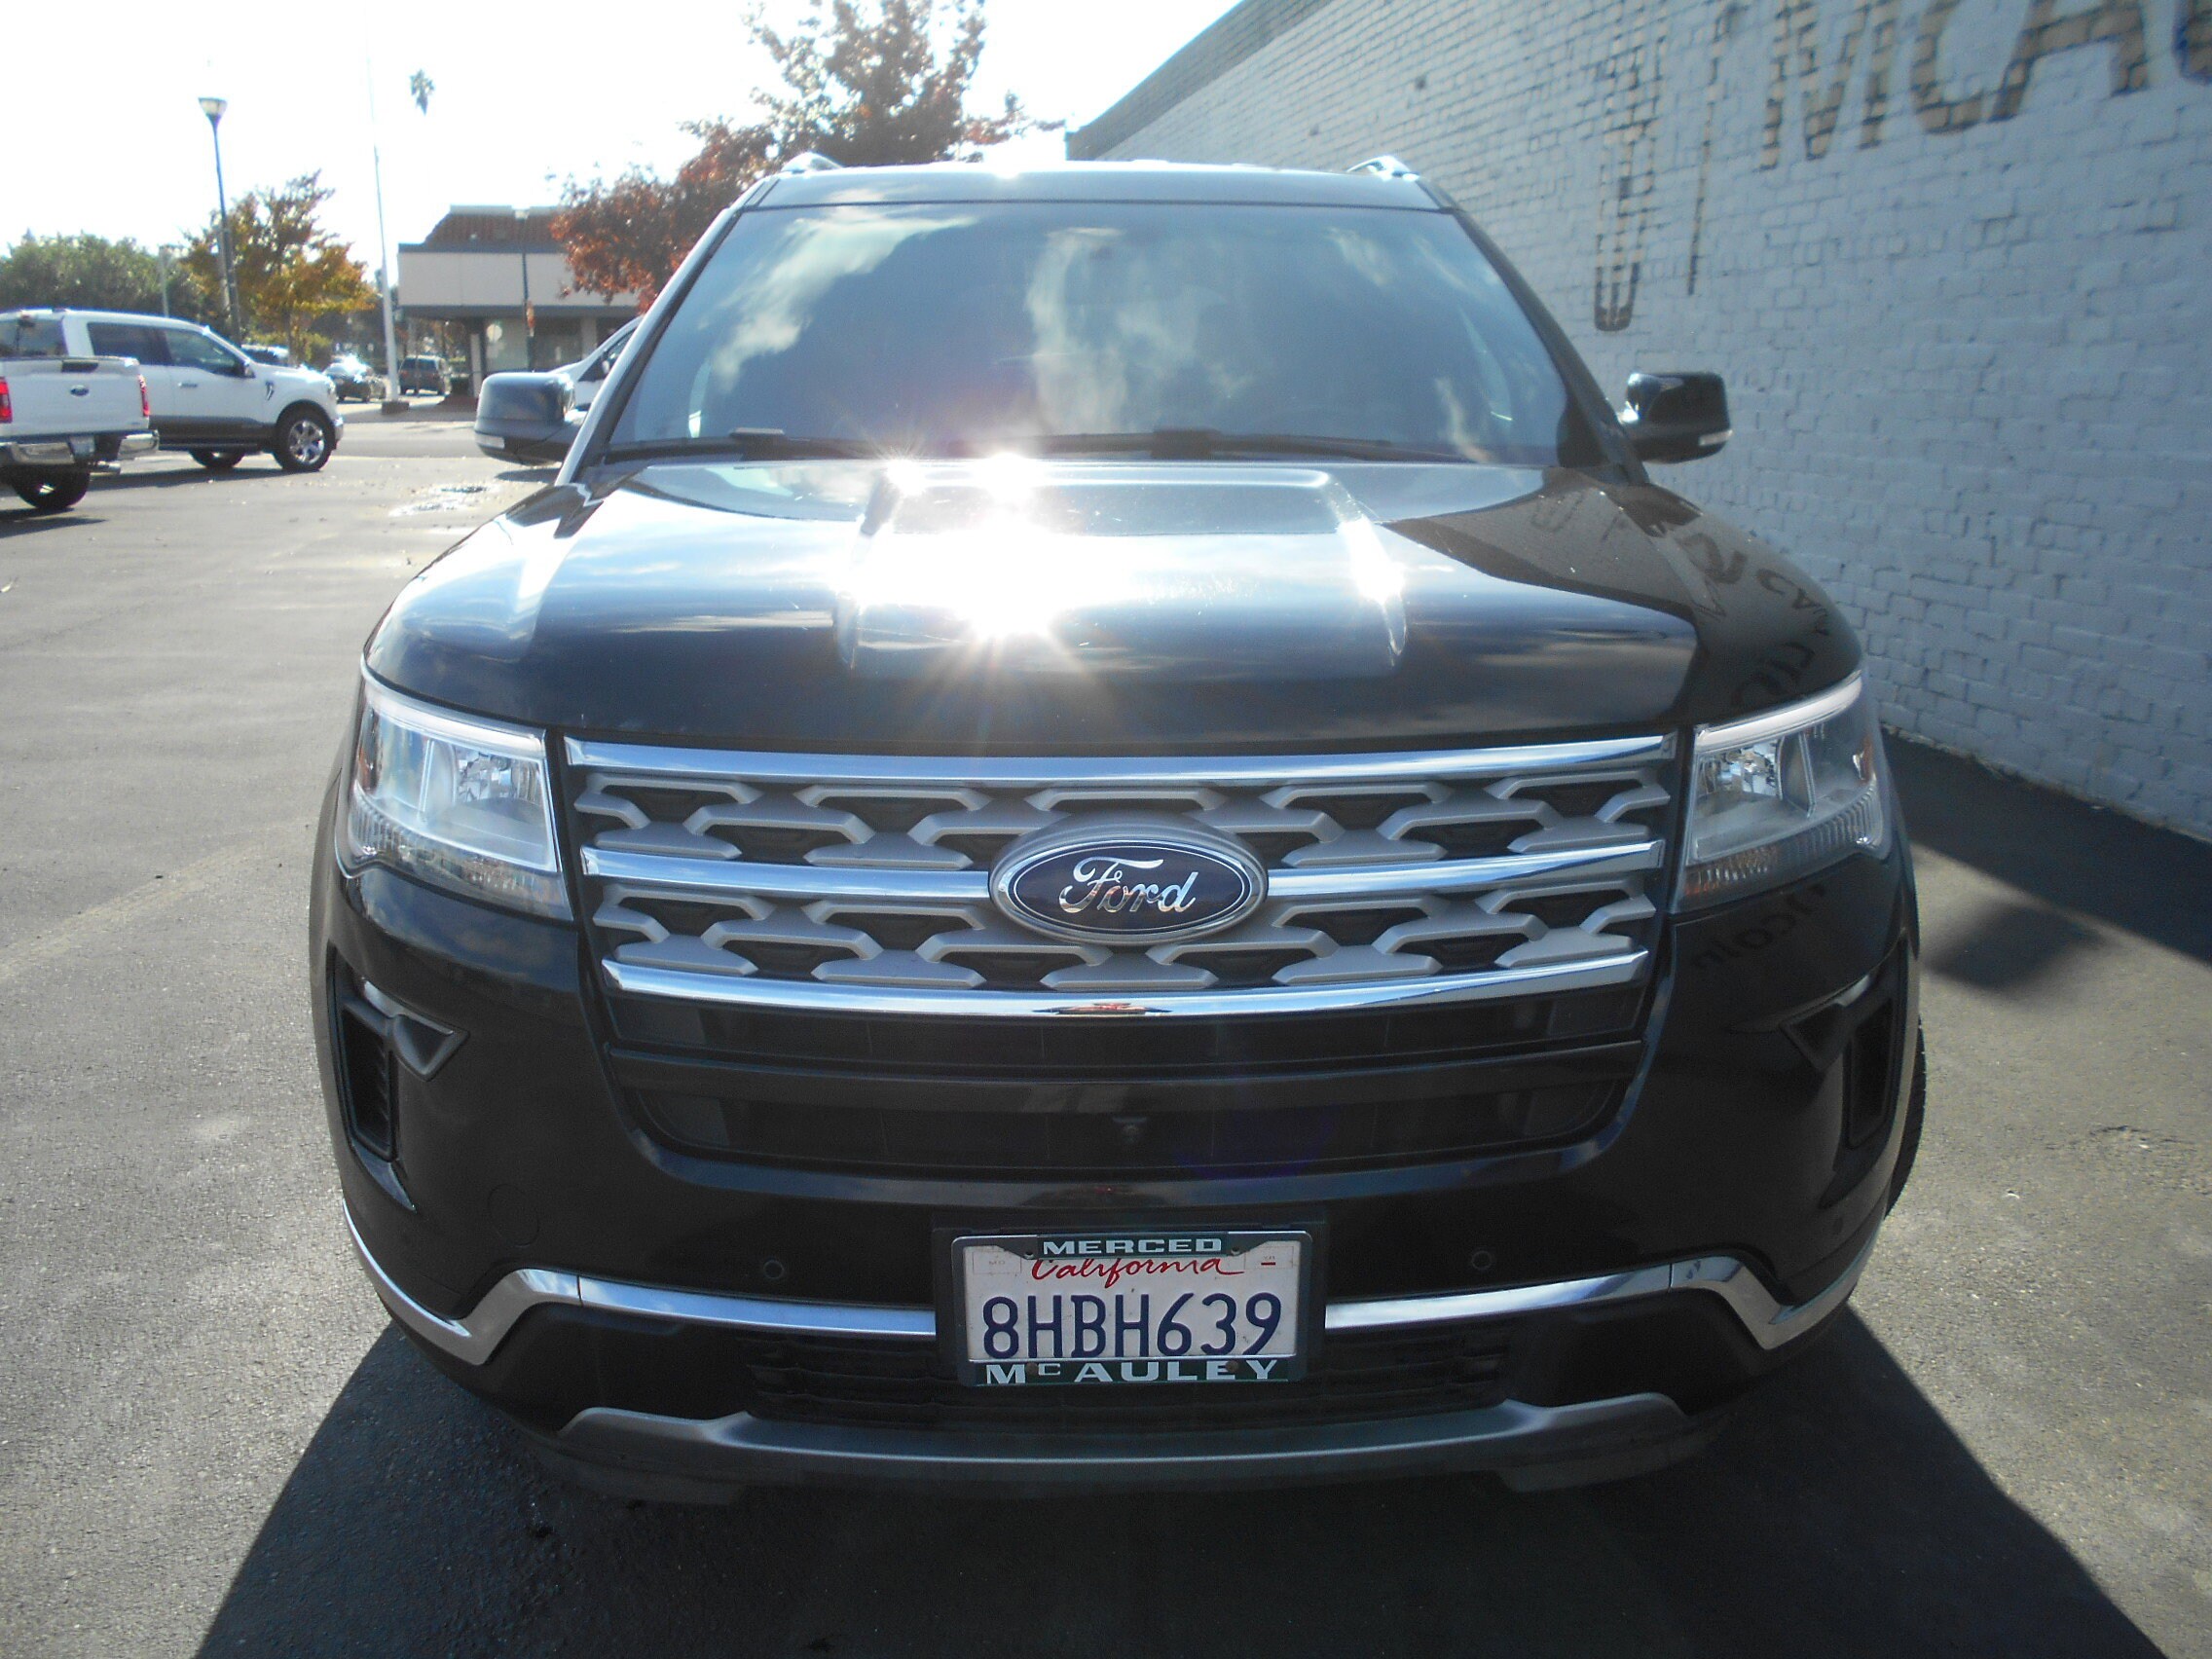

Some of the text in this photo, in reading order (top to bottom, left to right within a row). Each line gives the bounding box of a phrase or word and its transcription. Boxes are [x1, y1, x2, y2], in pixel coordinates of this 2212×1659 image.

[1058, 856, 1198, 913] Ford
[1043, 1238, 1223, 1255] MERCED
[1031, 1257, 1244, 1288] California
[982, 1292, 1282, 1359] 8HBH639
